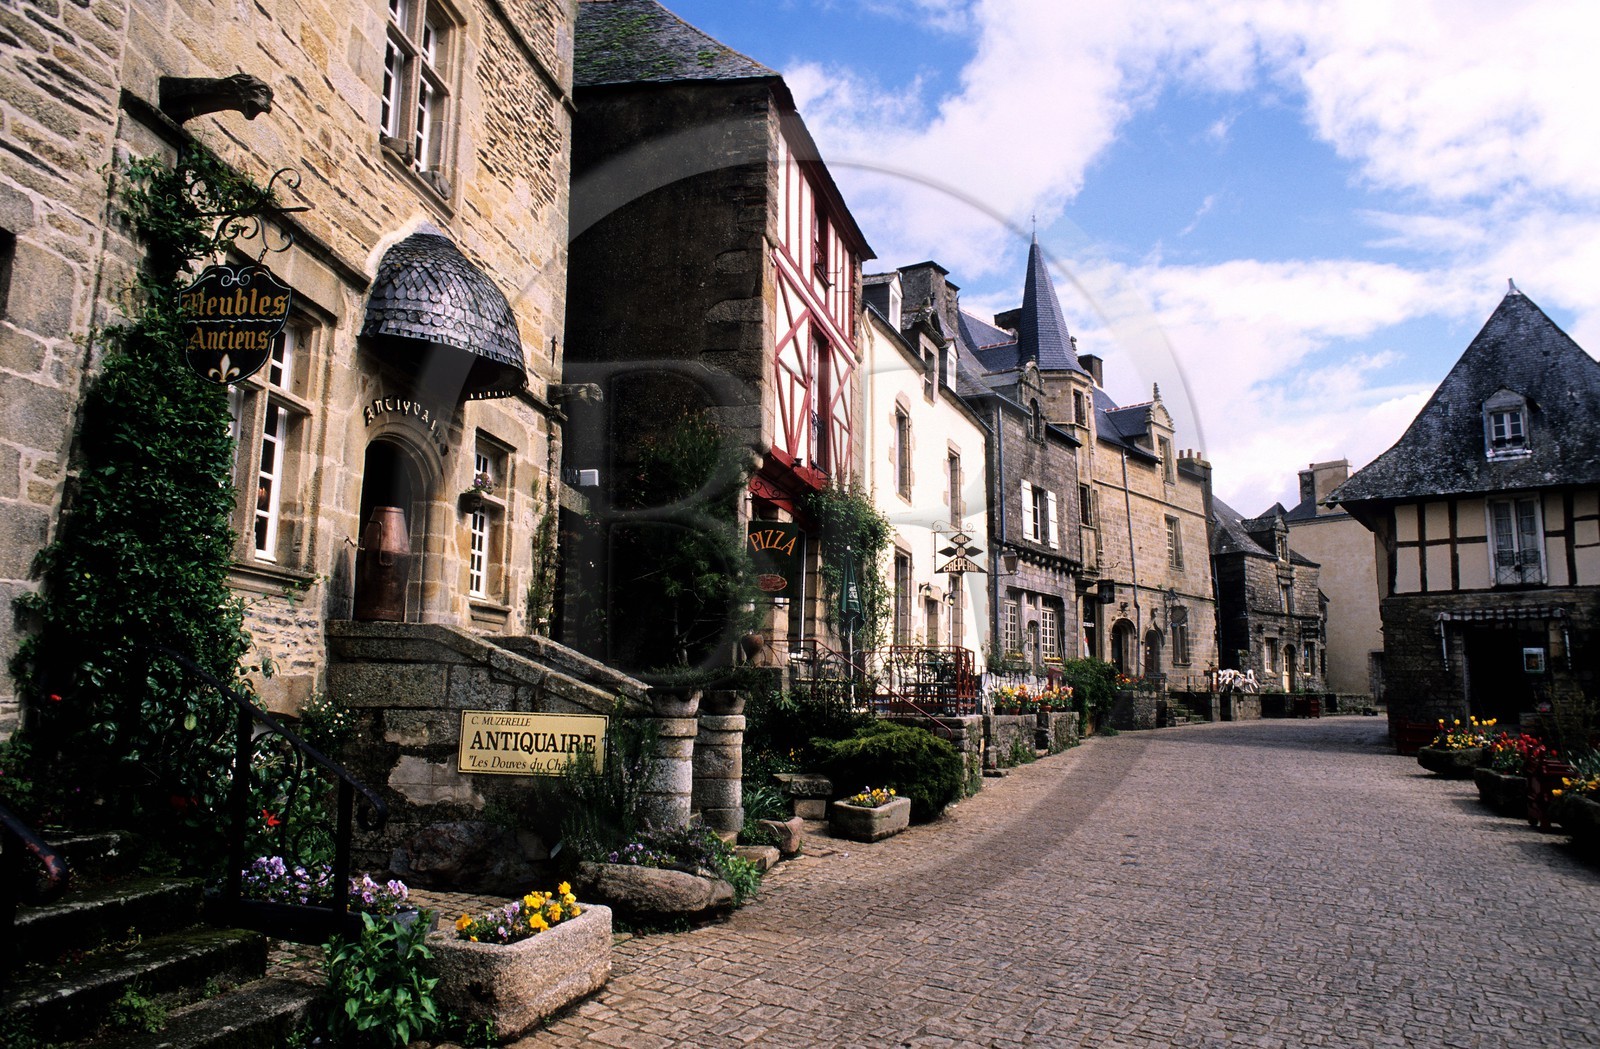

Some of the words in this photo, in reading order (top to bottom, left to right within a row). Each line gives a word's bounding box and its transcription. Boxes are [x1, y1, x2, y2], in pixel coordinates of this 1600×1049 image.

[186, 324, 272, 351] Anciens
[748, 529, 797, 557] PIZZA
[471, 716, 479, 725] C.
[481, 716, 532, 727] MUZERELLE
[469, 730, 597, 755] ANTIQUAIRE
[491, 756, 527, 770] Douves
[530, 757, 544, 770] du
